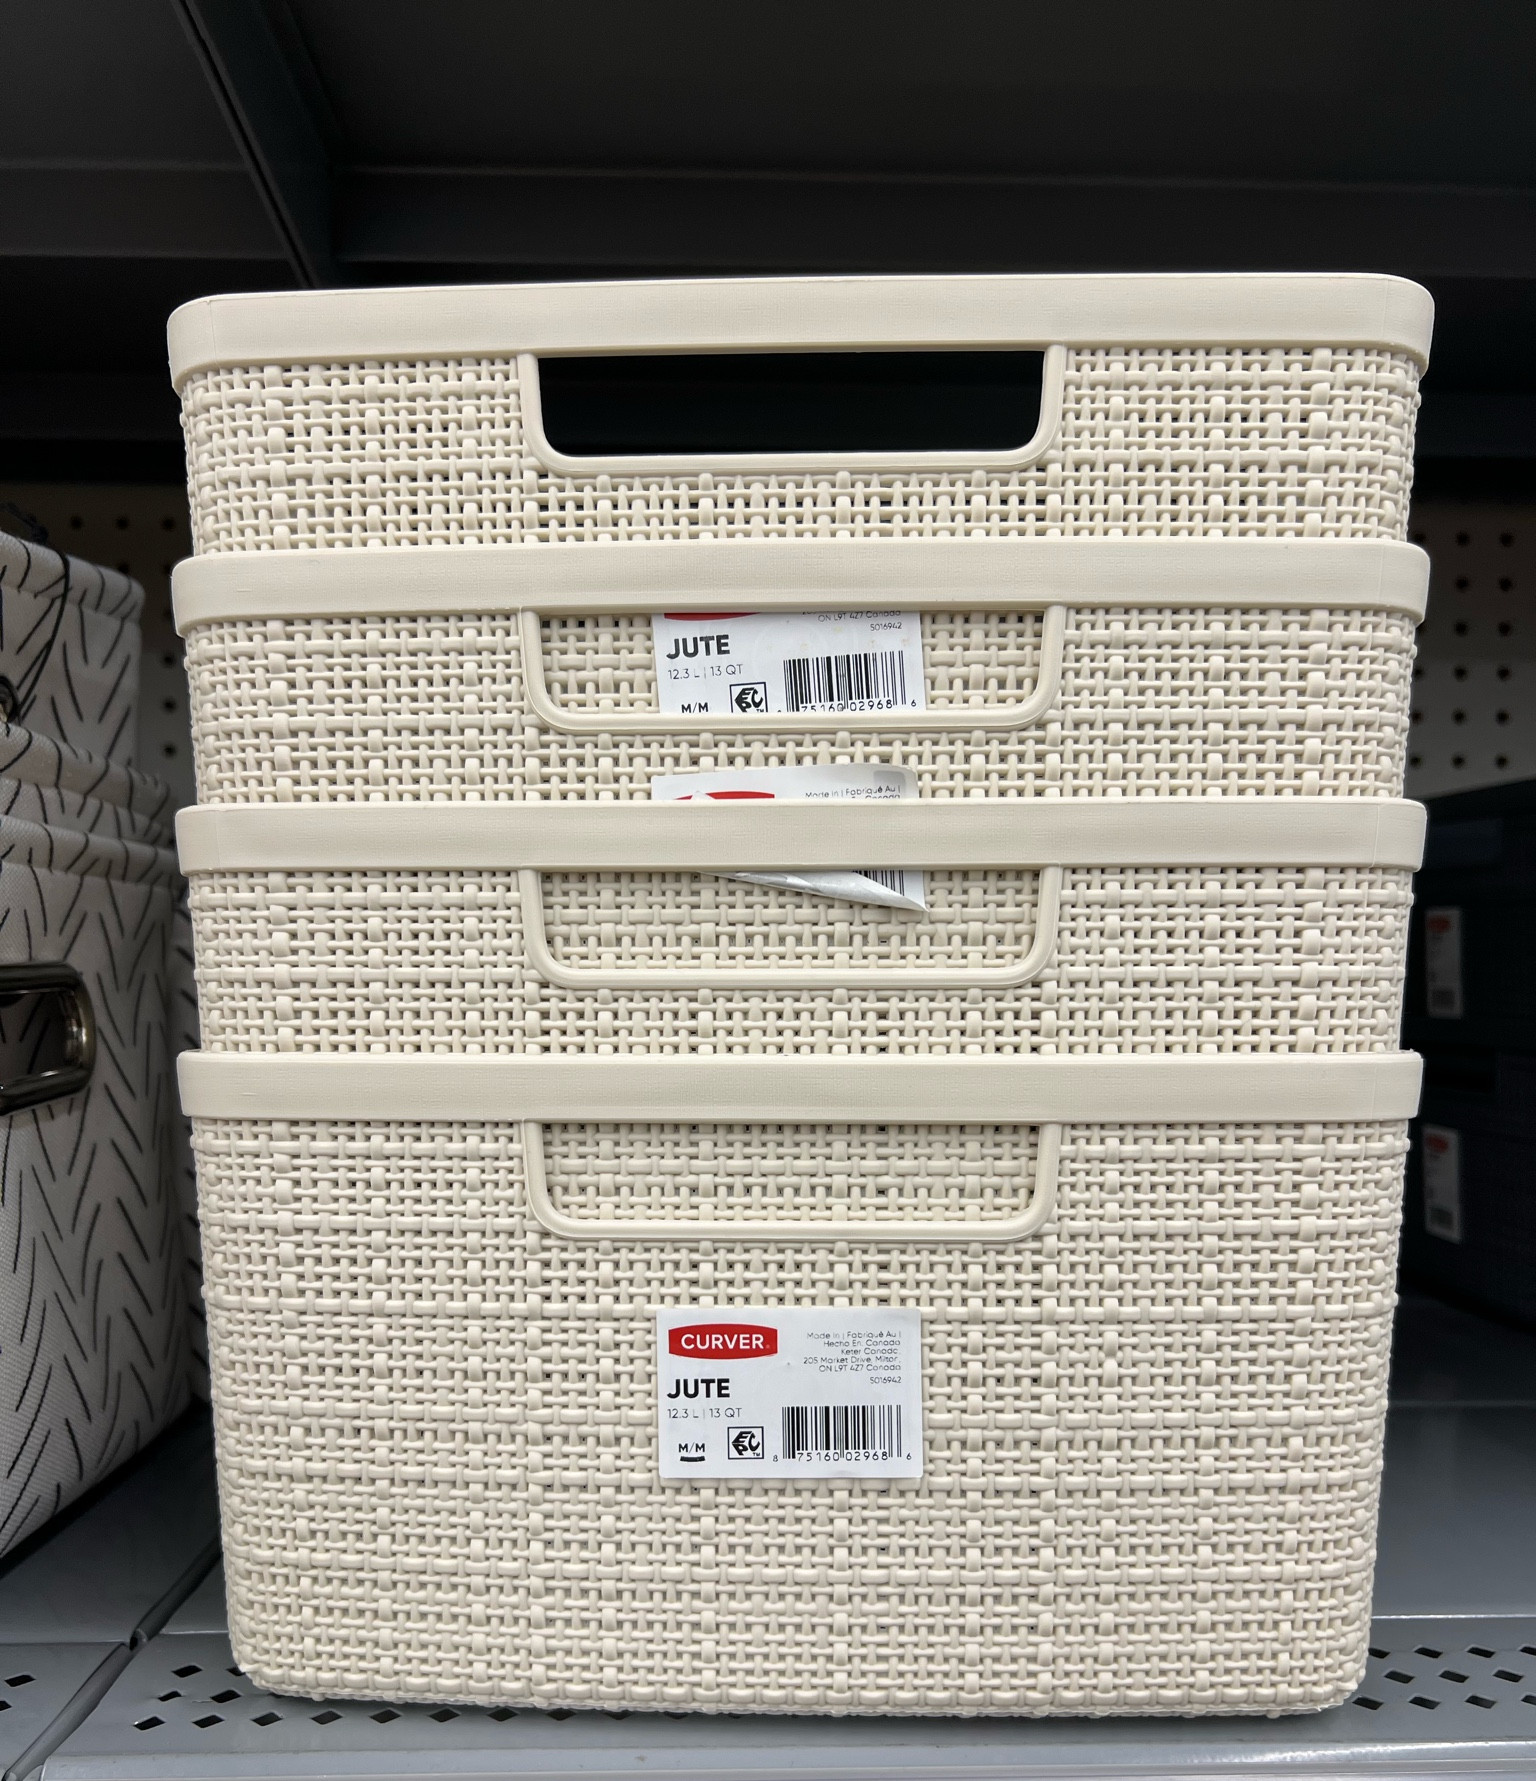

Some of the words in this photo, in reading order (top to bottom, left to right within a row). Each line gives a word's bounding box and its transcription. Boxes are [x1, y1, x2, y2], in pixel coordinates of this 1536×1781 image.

[817, 614, 832, 622] ON
[666, 634, 731, 660] JUTE
[668, 668, 690, 680] 12.3
[693, 668, 700, 679] L
[710, 665, 722, 677] 13
[725, 663, 744, 676] QT
[849, 699, 893, 712] 02968
[885, 785, 896, 793] Au
[807, 1332, 831, 1340] Made
[886, 1330, 897, 1338] Au
[681, 1333, 764, 1350] CURVER
[865, 1339, 901, 1347] Canada
[803, 1356, 819, 1365] 205
[820, 1356, 849, 1364] Market
[834, 1364, 848, 1372] L9T
[667, 1378, 730, 1399] JUTE
[667, 1408, 689, 1419] 12.3
[693, 1408, 699, 1418] L
[709, 1407, 721, 1418] 13
[724, 1407, 743, 1418] QT
[679, 1442, 705, 1453] M/M
[797, 1452, 840, 1462] 75160
[845, 1451, 888, 1462] 02968
[906, 1453, 912, 1461] 6
